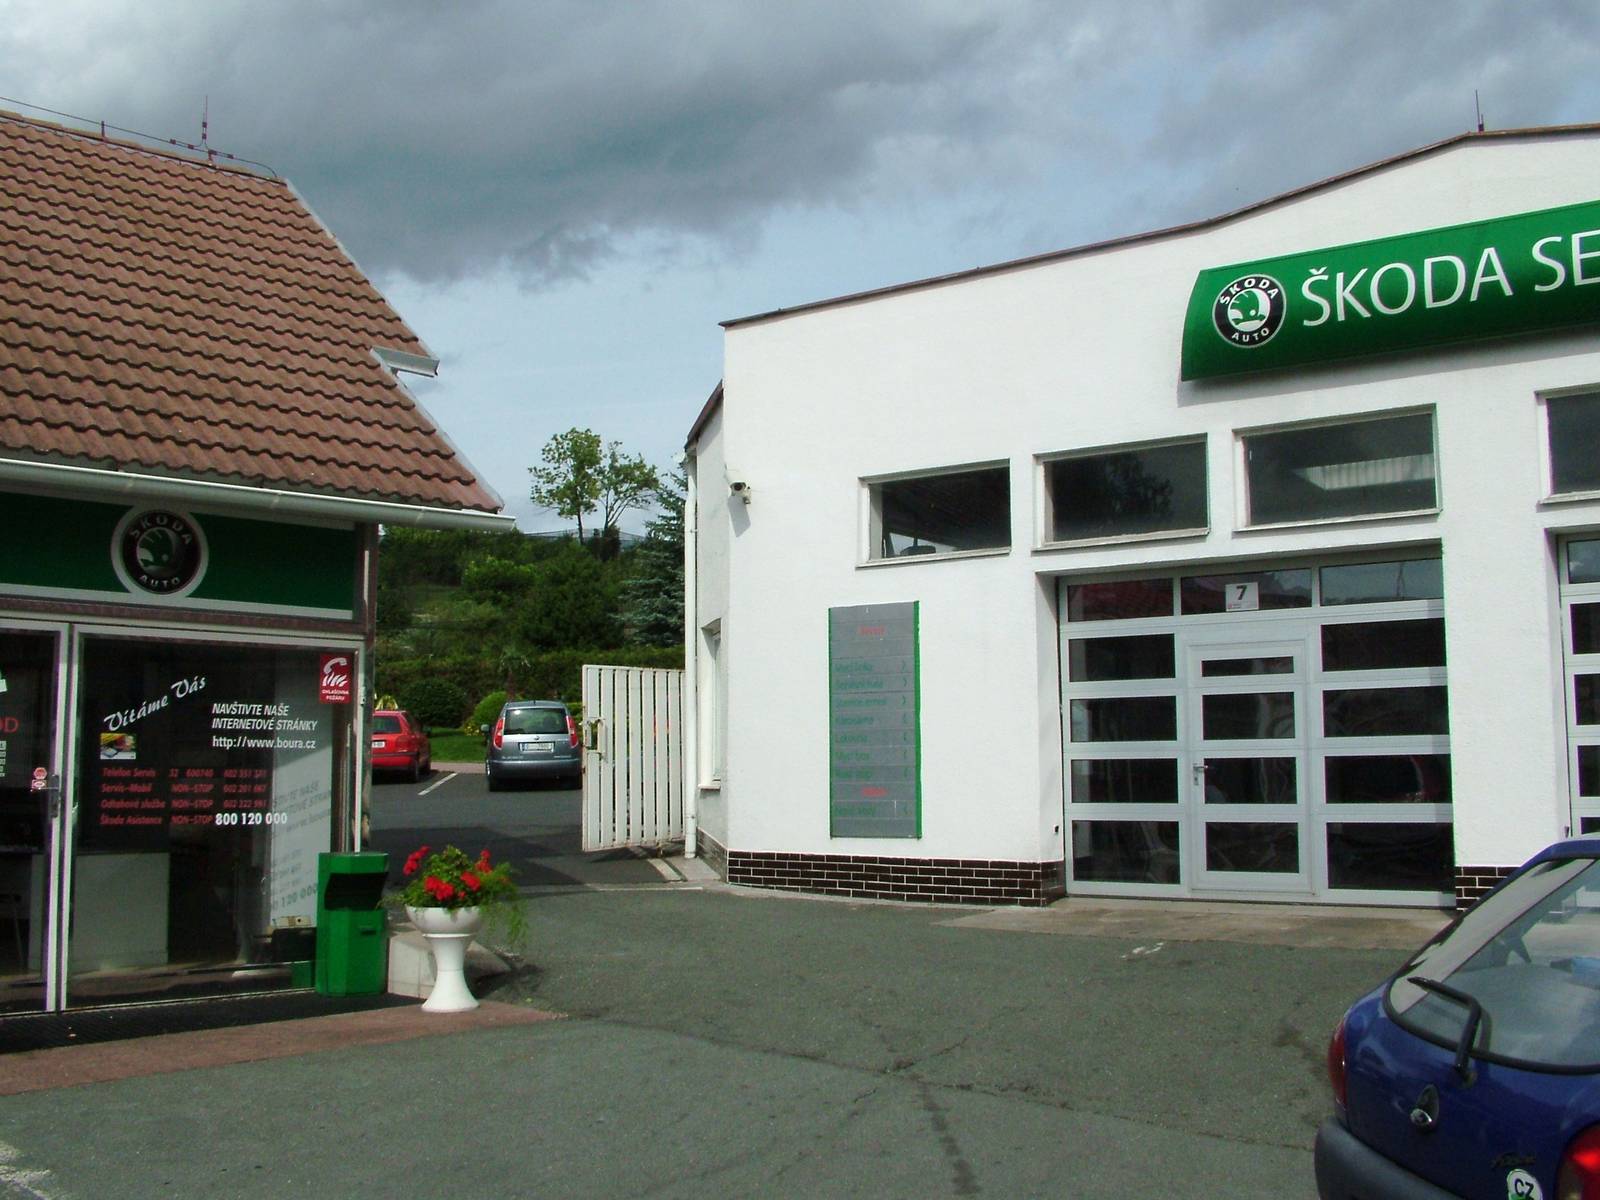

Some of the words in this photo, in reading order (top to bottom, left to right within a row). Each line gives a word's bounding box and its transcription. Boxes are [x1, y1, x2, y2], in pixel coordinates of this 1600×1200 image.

[1302, 247, 1514, 327] ŠKODA
[1532, 229, 1600, 292] SE
[1231, 326, 1271, 344] AUTO
[139, 574, 181, 588] AUTO
[1236, 585, 1248, 601] 7
[103, 695, 169, 731] Vítáme
[171, 675, 206, 699] Vás
[212, 701, 263, 716] NAVŠTIVTE
[263, 703, 290, 717] NAŠE
[212, 717, 275, 731] INTERNETOVÉ
[275, 718, 318, 732] STRÁNKY
[212, 736, 317, 750] http://www.boura.cz
[171, 783, 215, 793] NON-STOP
[171, 799, 215, 809] NON-STOP
[171, 815, 213, 825] NON-STOP
[215, 813, 238, 826] 800
[242, 813, 262, 825] 120
[265, 812, 288, 825] 000
[1514, 1178, 1535, 1199] CZ
